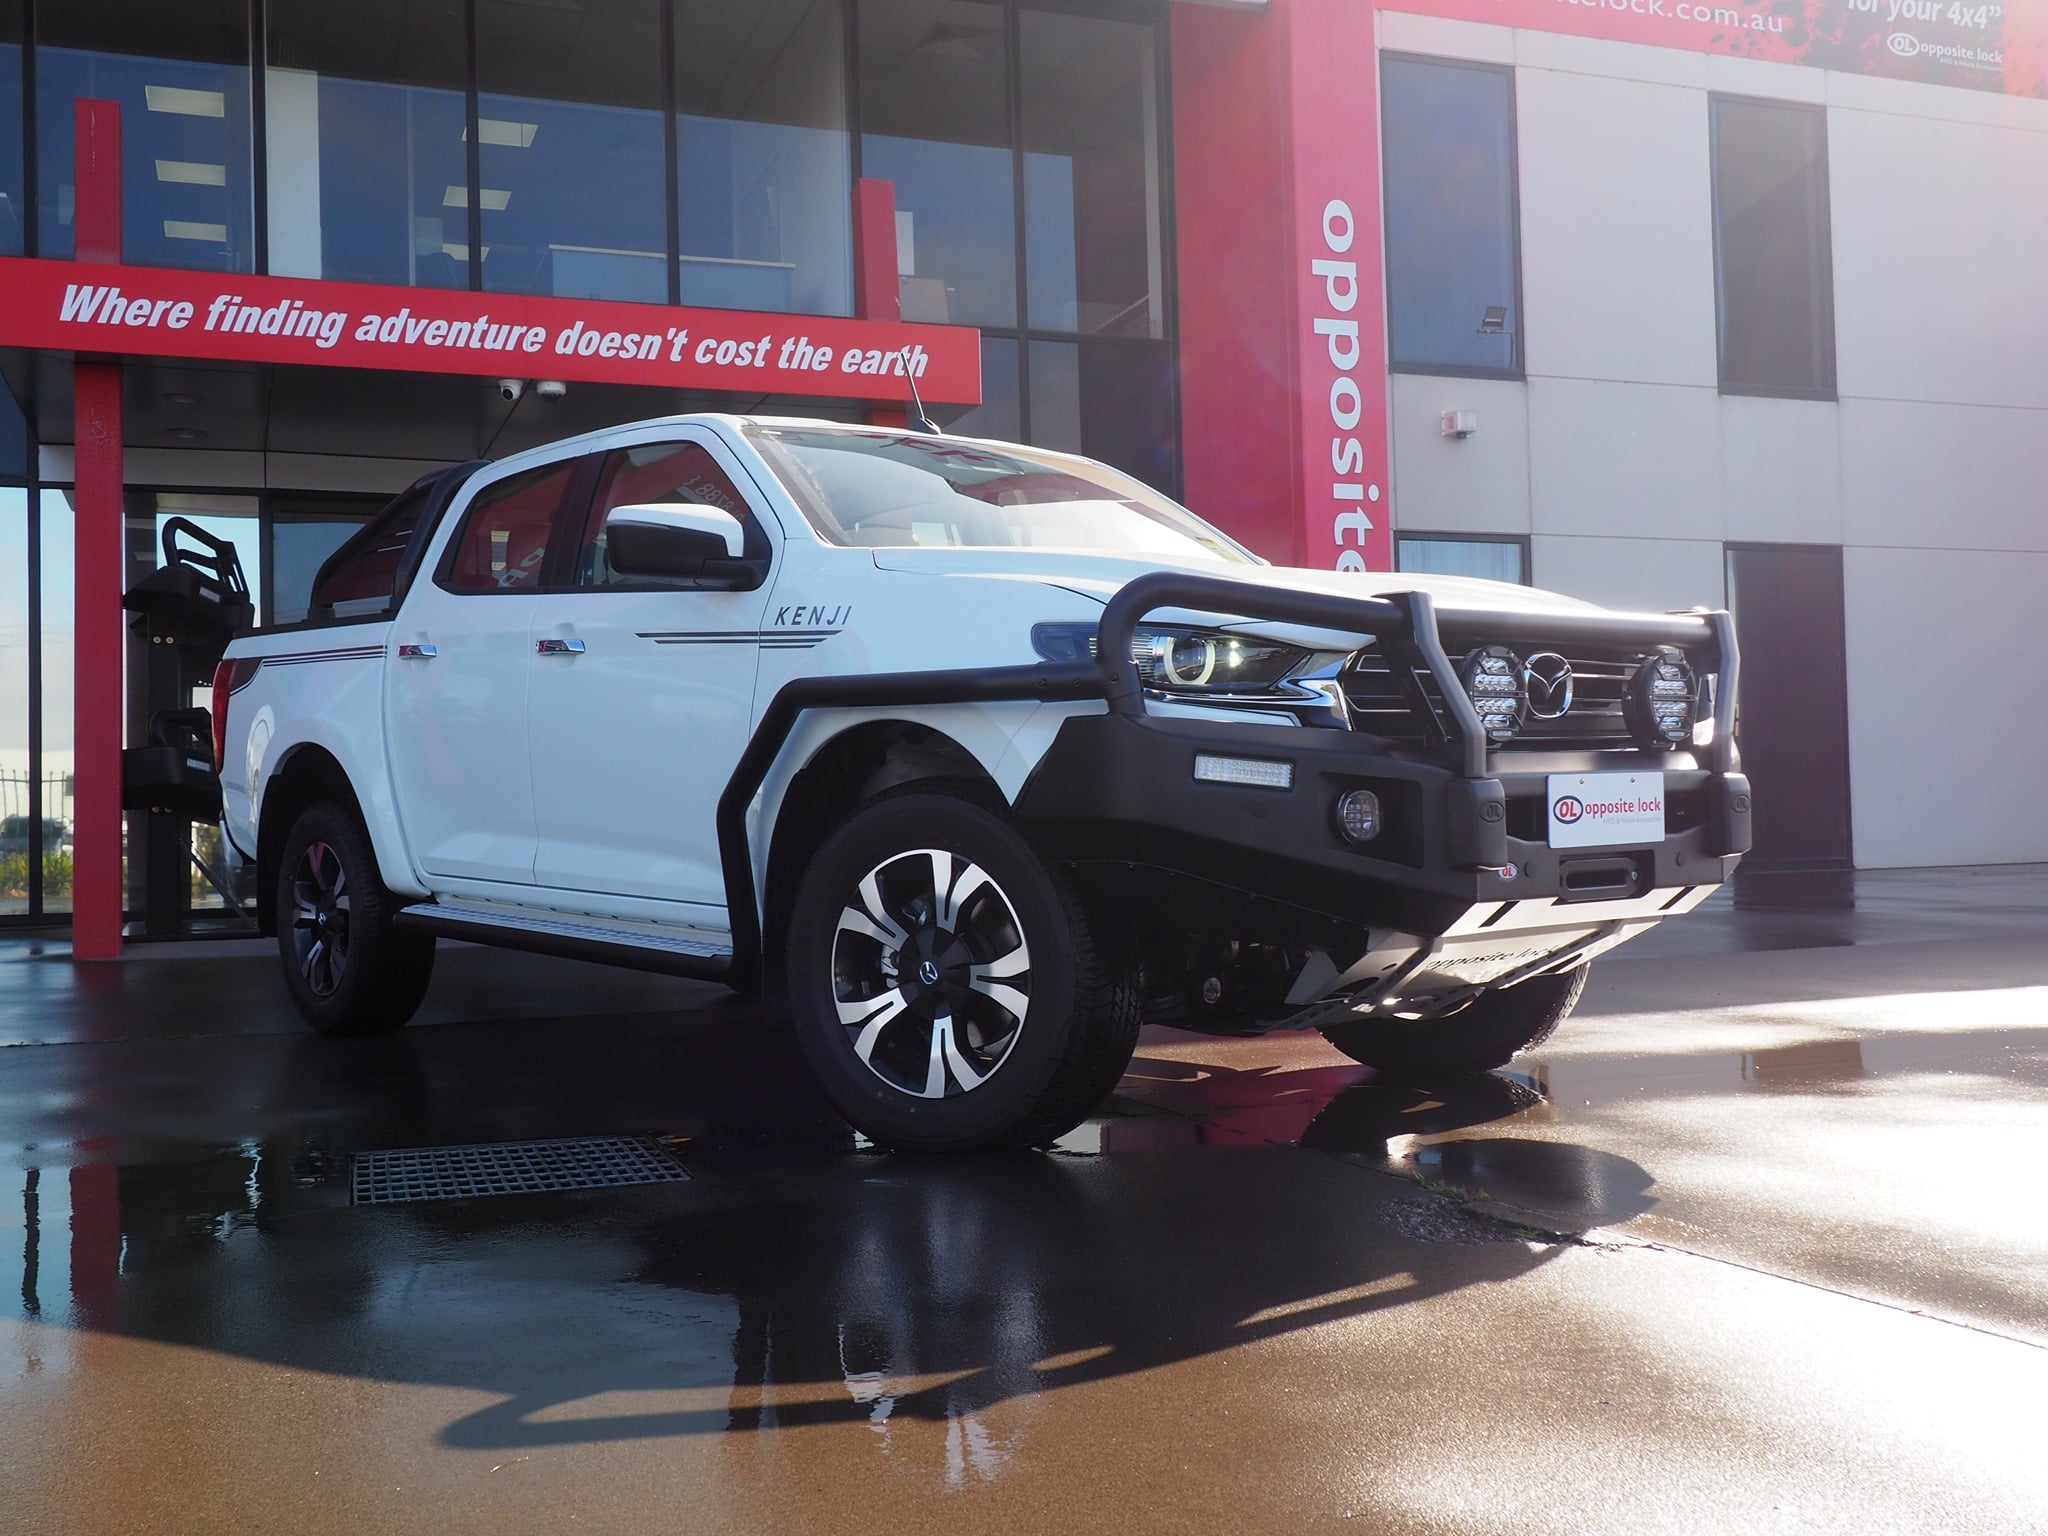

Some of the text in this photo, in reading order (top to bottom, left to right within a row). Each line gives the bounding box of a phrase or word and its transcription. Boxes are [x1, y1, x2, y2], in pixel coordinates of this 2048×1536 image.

[1557, 0, 1783, 33] ock.com.au
[1887, 0, 1943, 22] your
[1920, 42, 2003, 64] opposite lock
[60, 284, 929, 378] Where finding adventure doesn't cost the earth
[774, 605, 852, 626] KENJI
[1585, 796, 1661, 819] opposite lock
